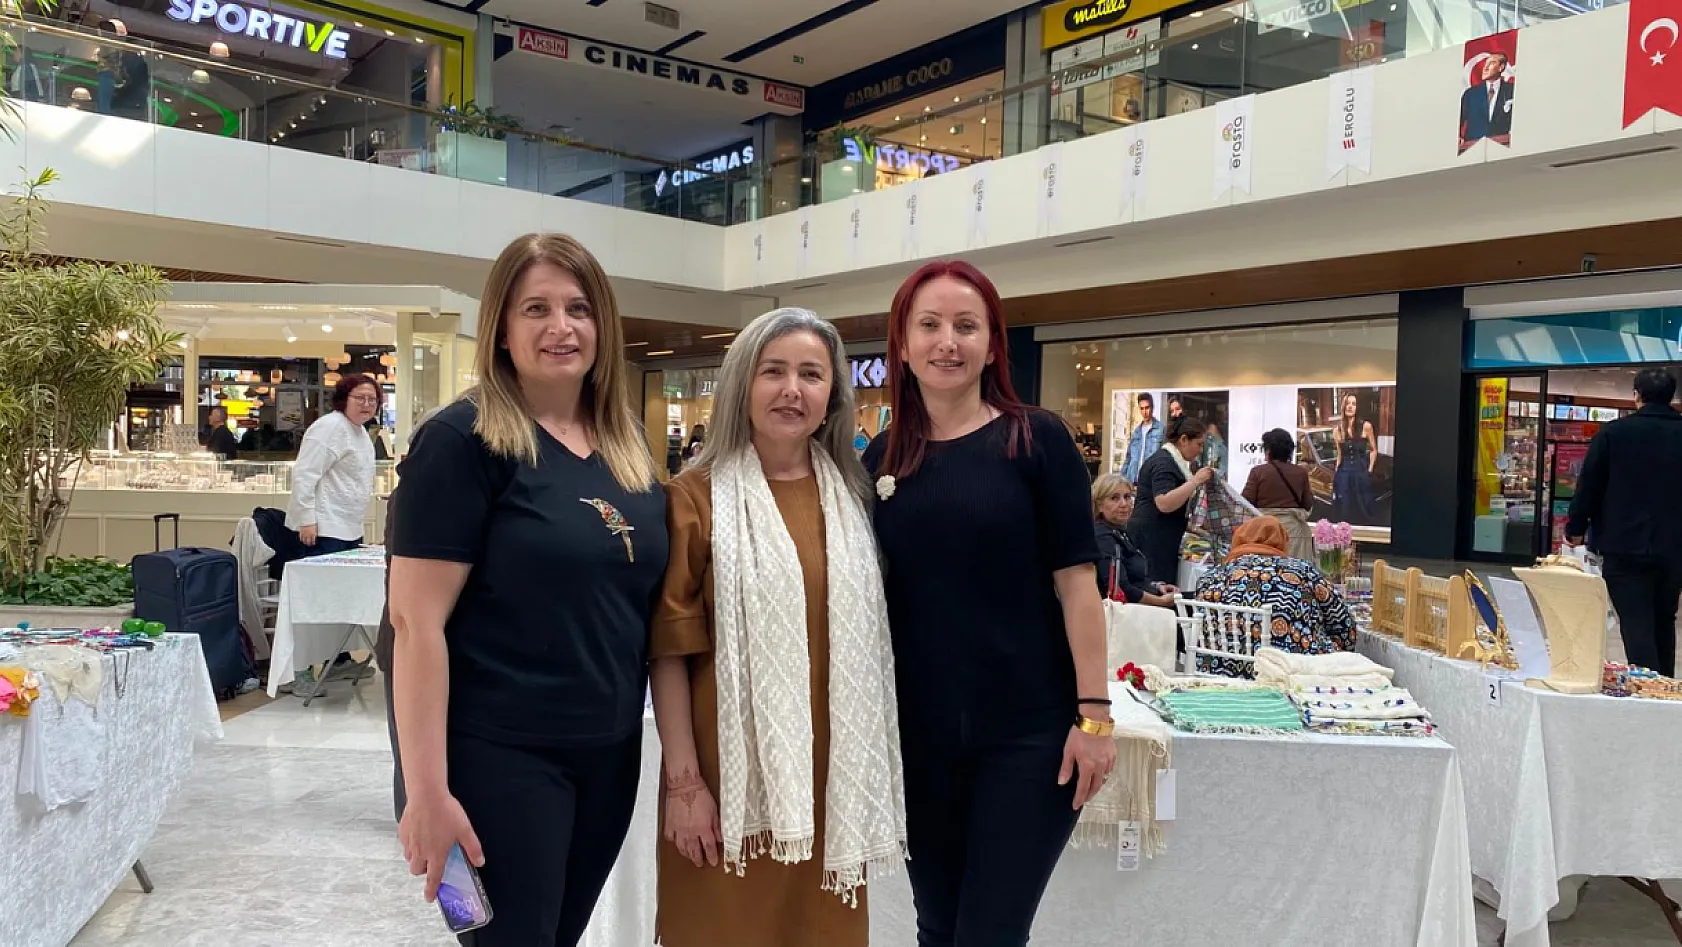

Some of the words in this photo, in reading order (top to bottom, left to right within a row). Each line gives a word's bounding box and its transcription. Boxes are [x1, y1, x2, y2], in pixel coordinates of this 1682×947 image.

[164, 0, 350, 60] SPORTIVE
[584, 46, 750, 95] CINEMAS
[905, 57, 954, 87] COCO
[1344, 87, 1355, 138] EROĞLU
[1133, 139, 1143, 176] erasta
[1232, 116, 1242, 169] erasta
[672, 145, 754, 186] CINEMAS
[1047, 162, 1056, 199] erasta
[1489, 684, 1496, 700] 2
